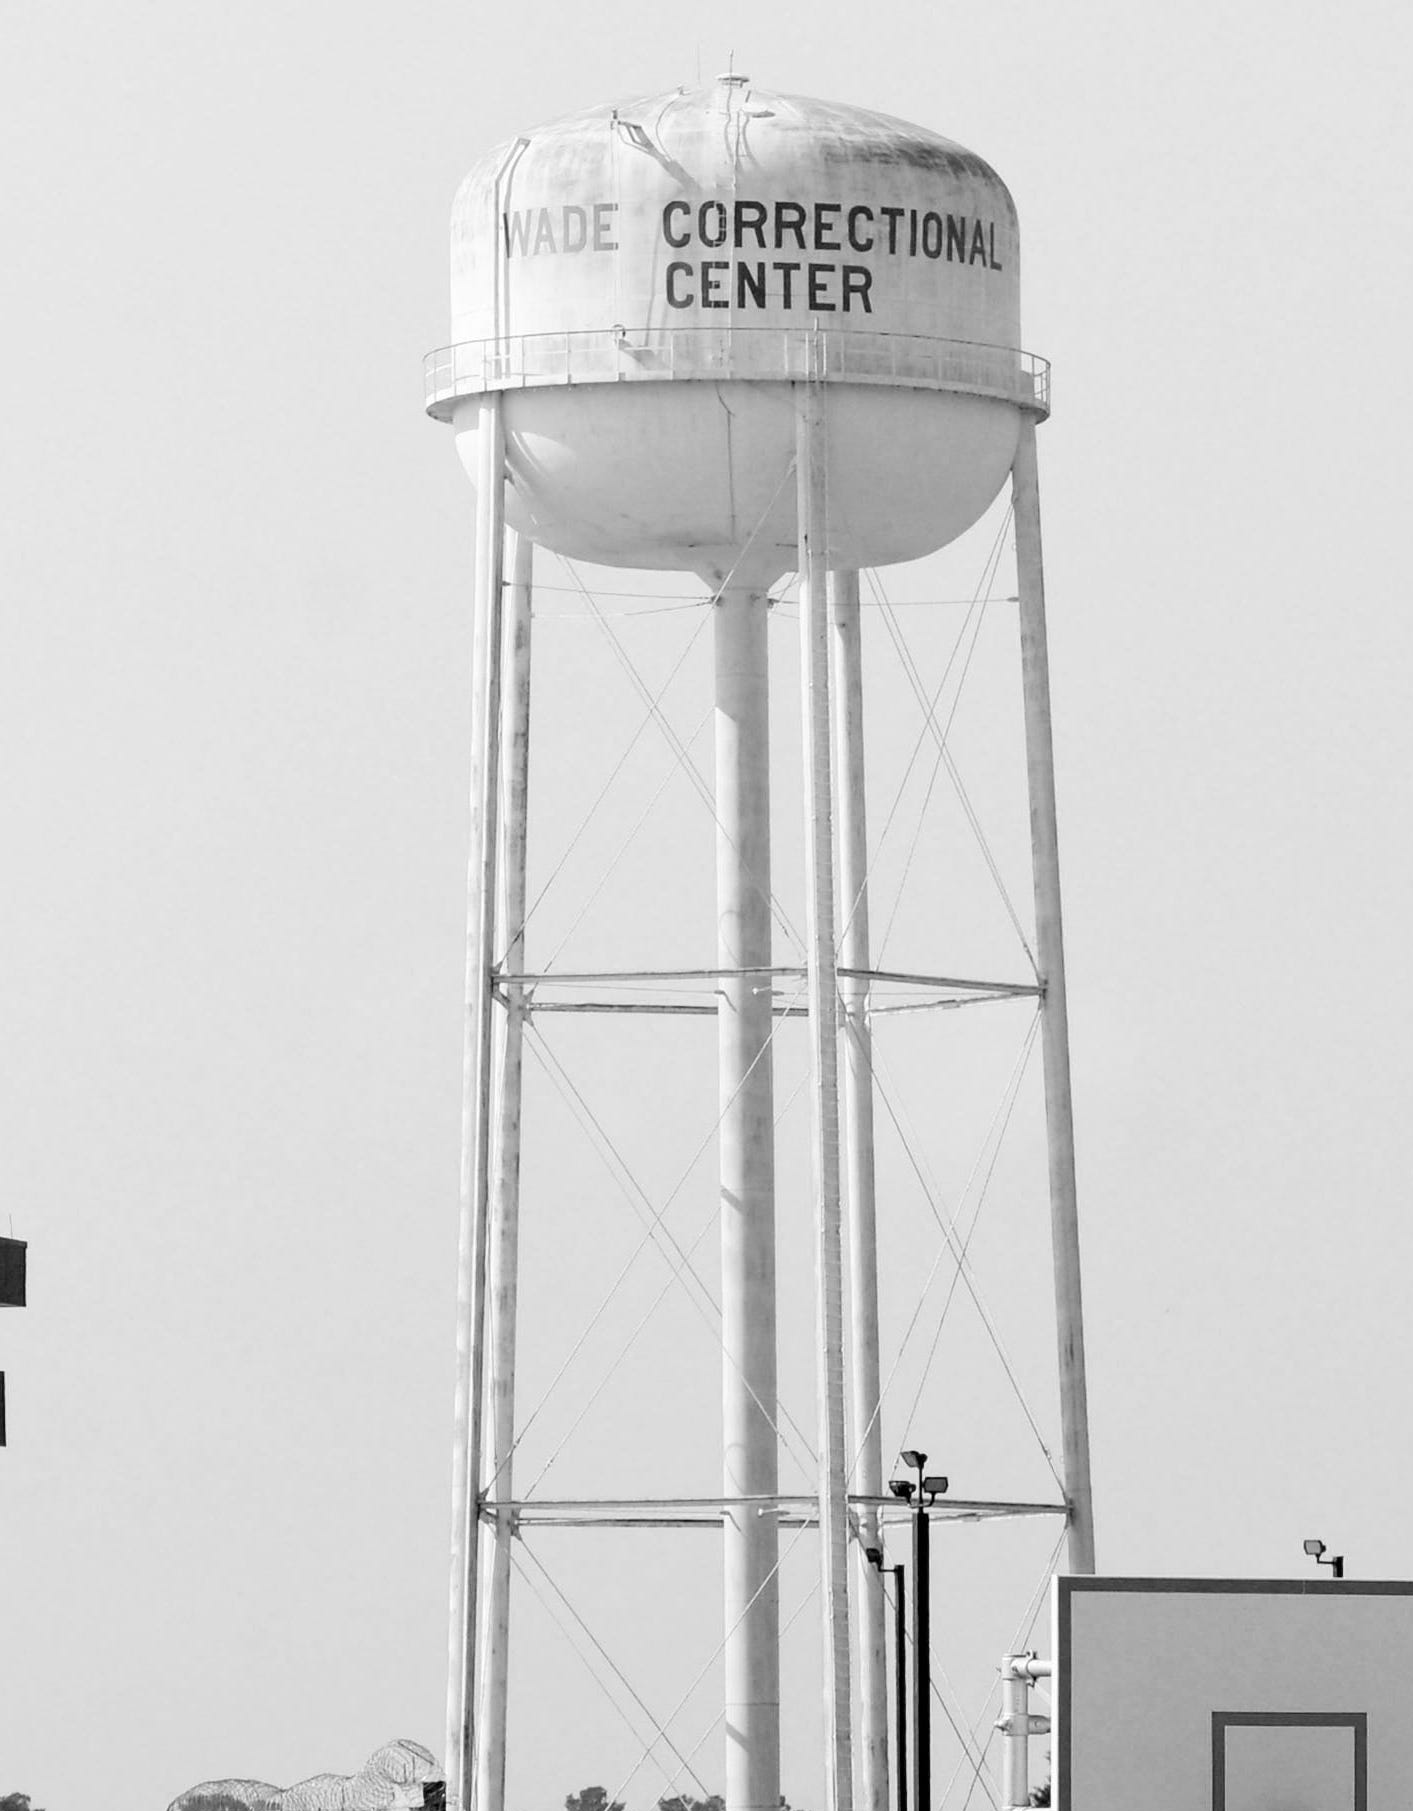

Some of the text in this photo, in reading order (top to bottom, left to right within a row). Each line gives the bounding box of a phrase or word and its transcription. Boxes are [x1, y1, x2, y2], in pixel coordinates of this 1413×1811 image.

[502, 200, 1003, 272] WADE CORRECTIONAL
[666, 261, 873, 314] CENTER
